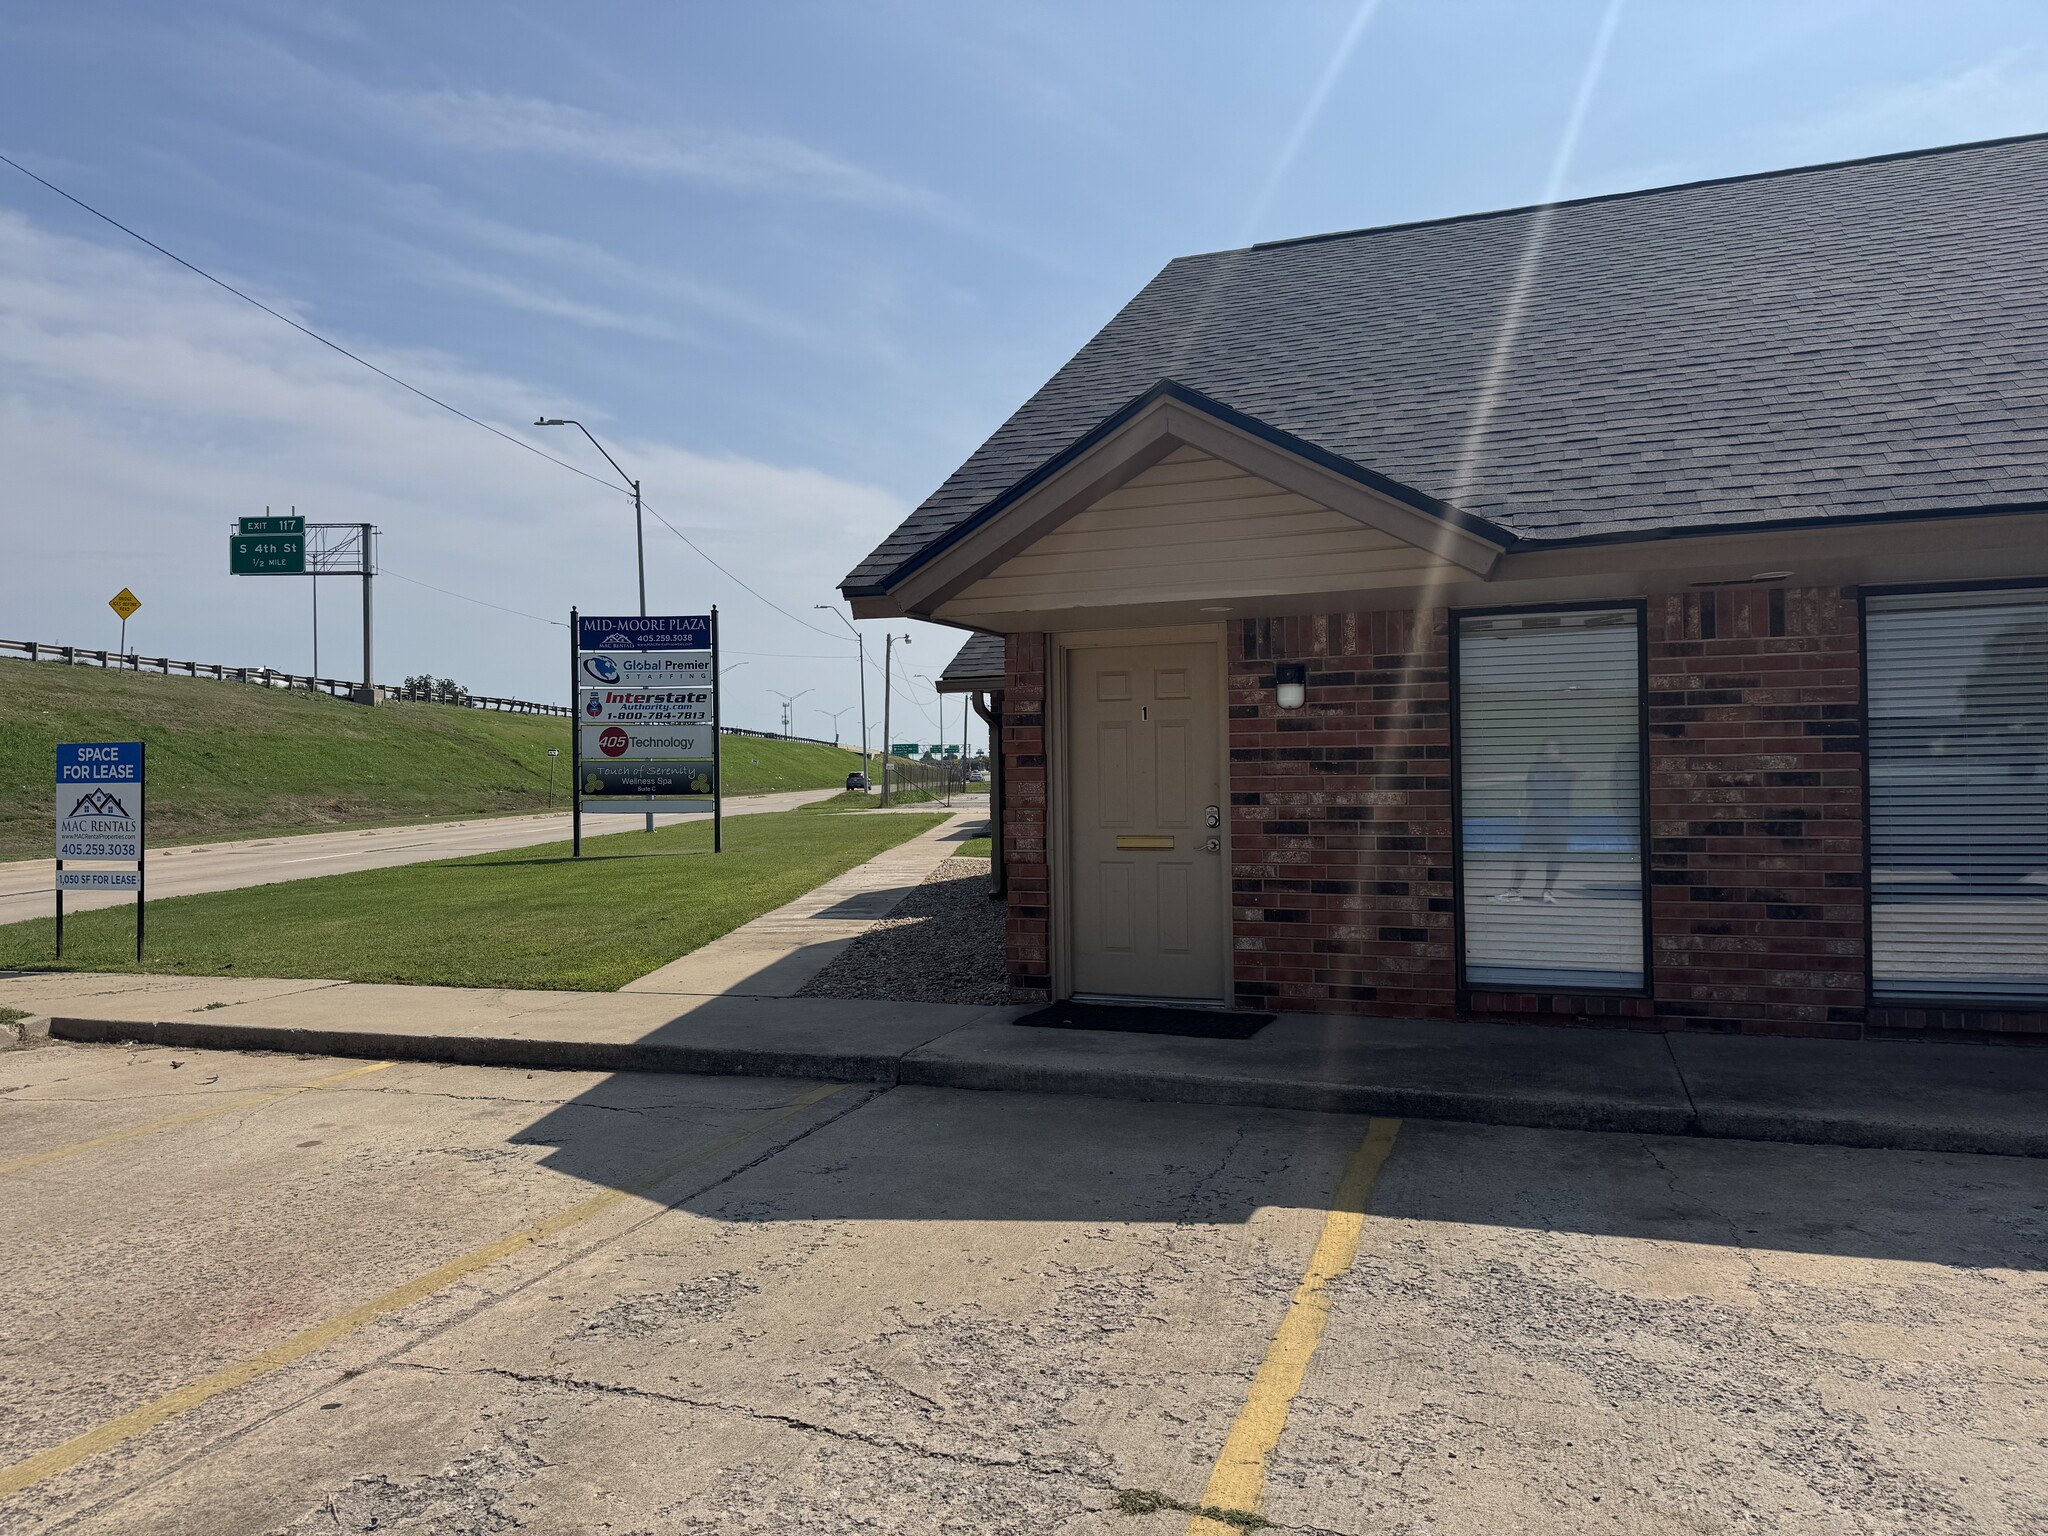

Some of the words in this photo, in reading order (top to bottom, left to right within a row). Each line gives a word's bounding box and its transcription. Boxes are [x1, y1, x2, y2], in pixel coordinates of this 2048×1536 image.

[247, 522, 267, 530] EXIT
[279, 520, 296, 531] 117
[240, 544, 247, 553] S
[254, 544, 276, 553] 4th
[284, 544, 297, 553] St
[584, 620, 666, 631] MID-MOORE
[670, 618, 706, 630] PLAZA
[623, 660, 661, 670] Global
[665, 660, 710, 670] Premier
[606, 692, 708, 704] Interstate
[620, 704, 692, 712] Authority.com
[1142, 706, 1148, 721] 1
[599, 737, 626, 748] 405
[629, 737, 694, 750] Technology
[78, 748, 118, 762] SPACE
[64, 766, 90, 779] FOR
[94, 765, 134, 778] LEASE
[597, 767, 629, 775] Touch
[633, 765, 645, 778] of
[646, 766, 696, 779] Serenity
[62, 820, 86, 832] MAC
[91, 820, 136, 832] RENTALS
[62, 844, 135, 856] 405.259.3038
[59, 875, 79, 884] 1,050
[81, 876, 90, 884] SF
[92, 876, 108, 884] FOR
[111, 876, 136, 884] LEASE
